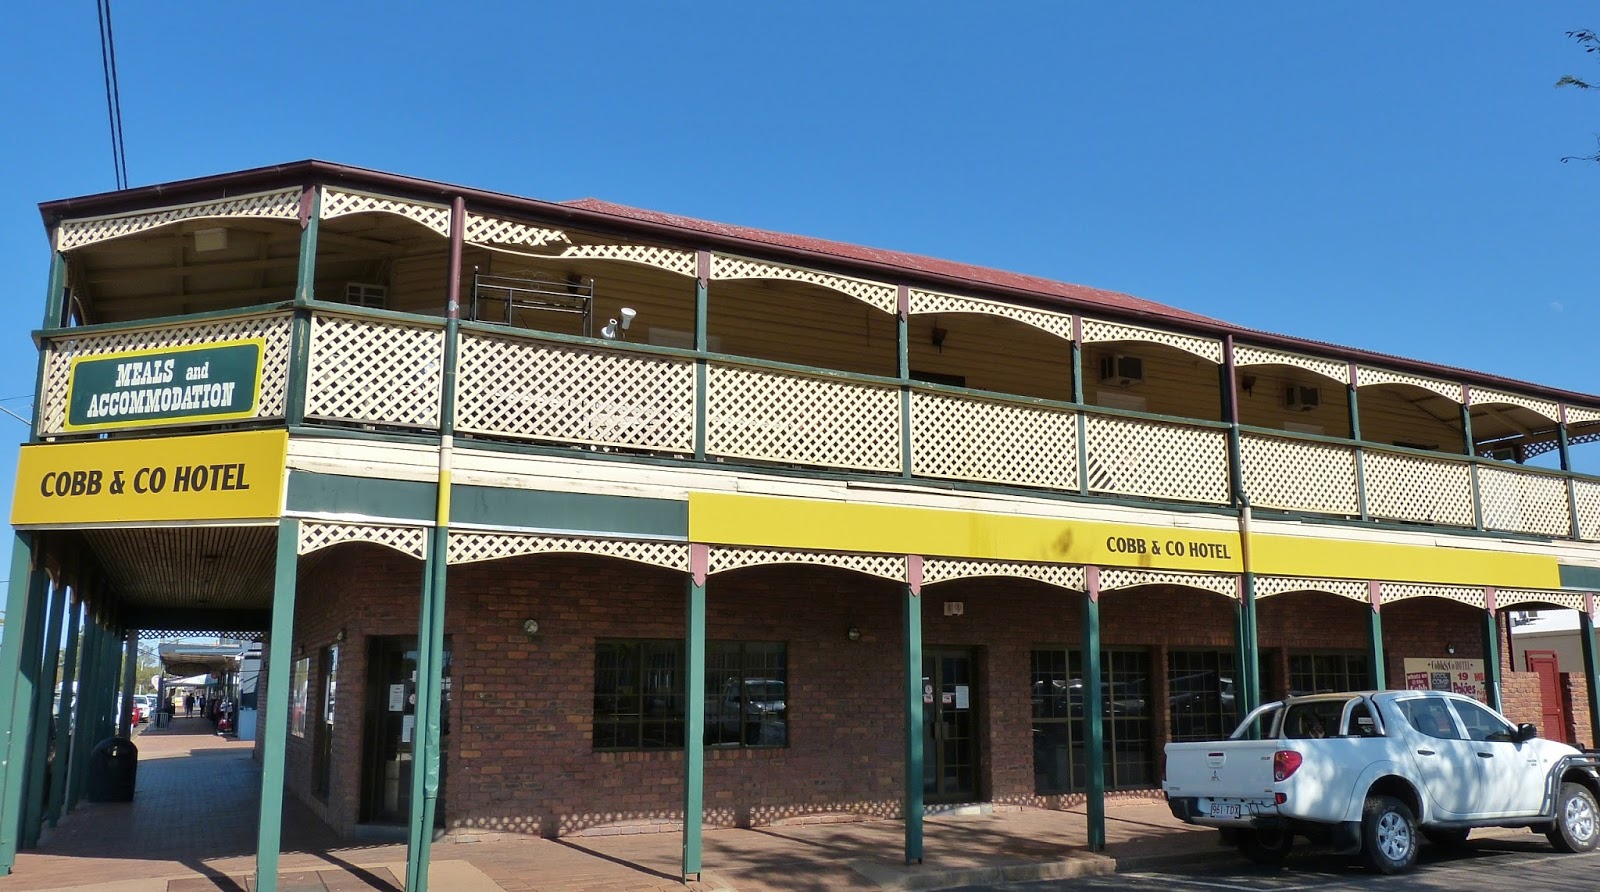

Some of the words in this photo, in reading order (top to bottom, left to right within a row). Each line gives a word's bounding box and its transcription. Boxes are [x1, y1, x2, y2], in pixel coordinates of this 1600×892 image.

[115, 359, 175, 387] MEALS
[186, 361, 209, 381] and
[86, 382, 235, 418] ACCOMMODATION
[40, 470, 103, 497] COBB
[109, 470, 125, 495] &
[133, 466, 167, 494] CO
[172, 462, 249, 493] HOTEL
[1106, 536, 1147, 554] COBB
[1151, 540, 1161, 555] &
[1165, 540, 1185, 557] CO
[1189, 541, 1231, 560] HOTEL
[1452, 681, 1476, 694] Pokies
[1457, 672, 1469, 681] 19
